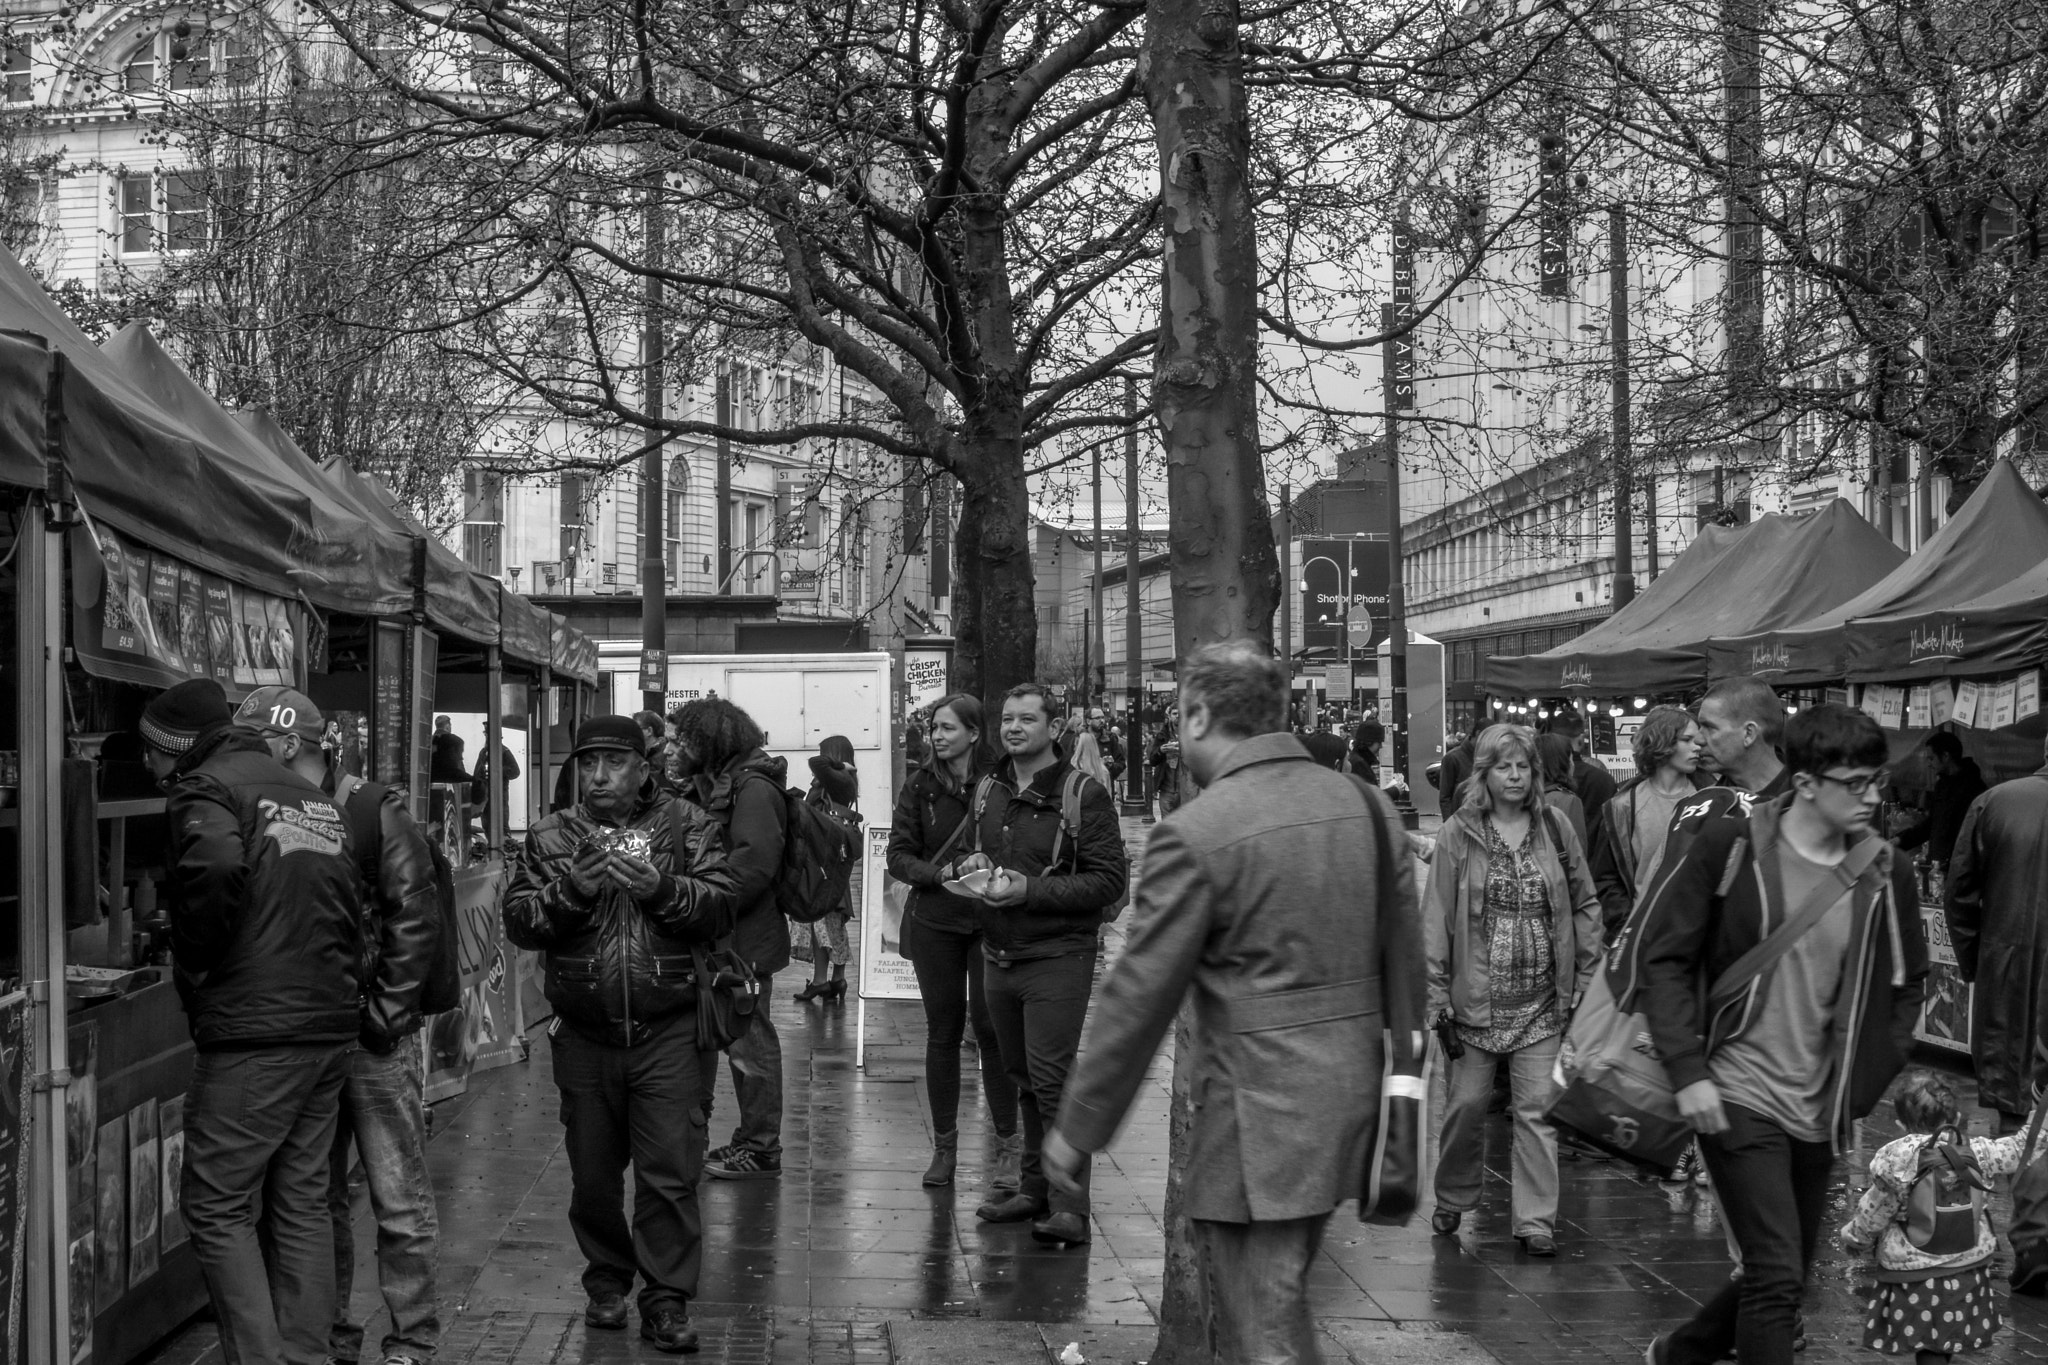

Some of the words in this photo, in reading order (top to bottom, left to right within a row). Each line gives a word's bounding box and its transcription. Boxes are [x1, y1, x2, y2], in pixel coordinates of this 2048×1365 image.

[1395, 235, 1411, 395] DEBENAMS
[1317, 594, 1338, 603] Shot
[1353, 594, 1385, 603] iPhone
[910, 660, 941, 671] CRISPY
[907, 668, 946, 680] CHICKEN
[270, 705, 296, 728] 10
[870, 831, 889, 840] VE
[873, 967, 905, 975] FALAFEL
